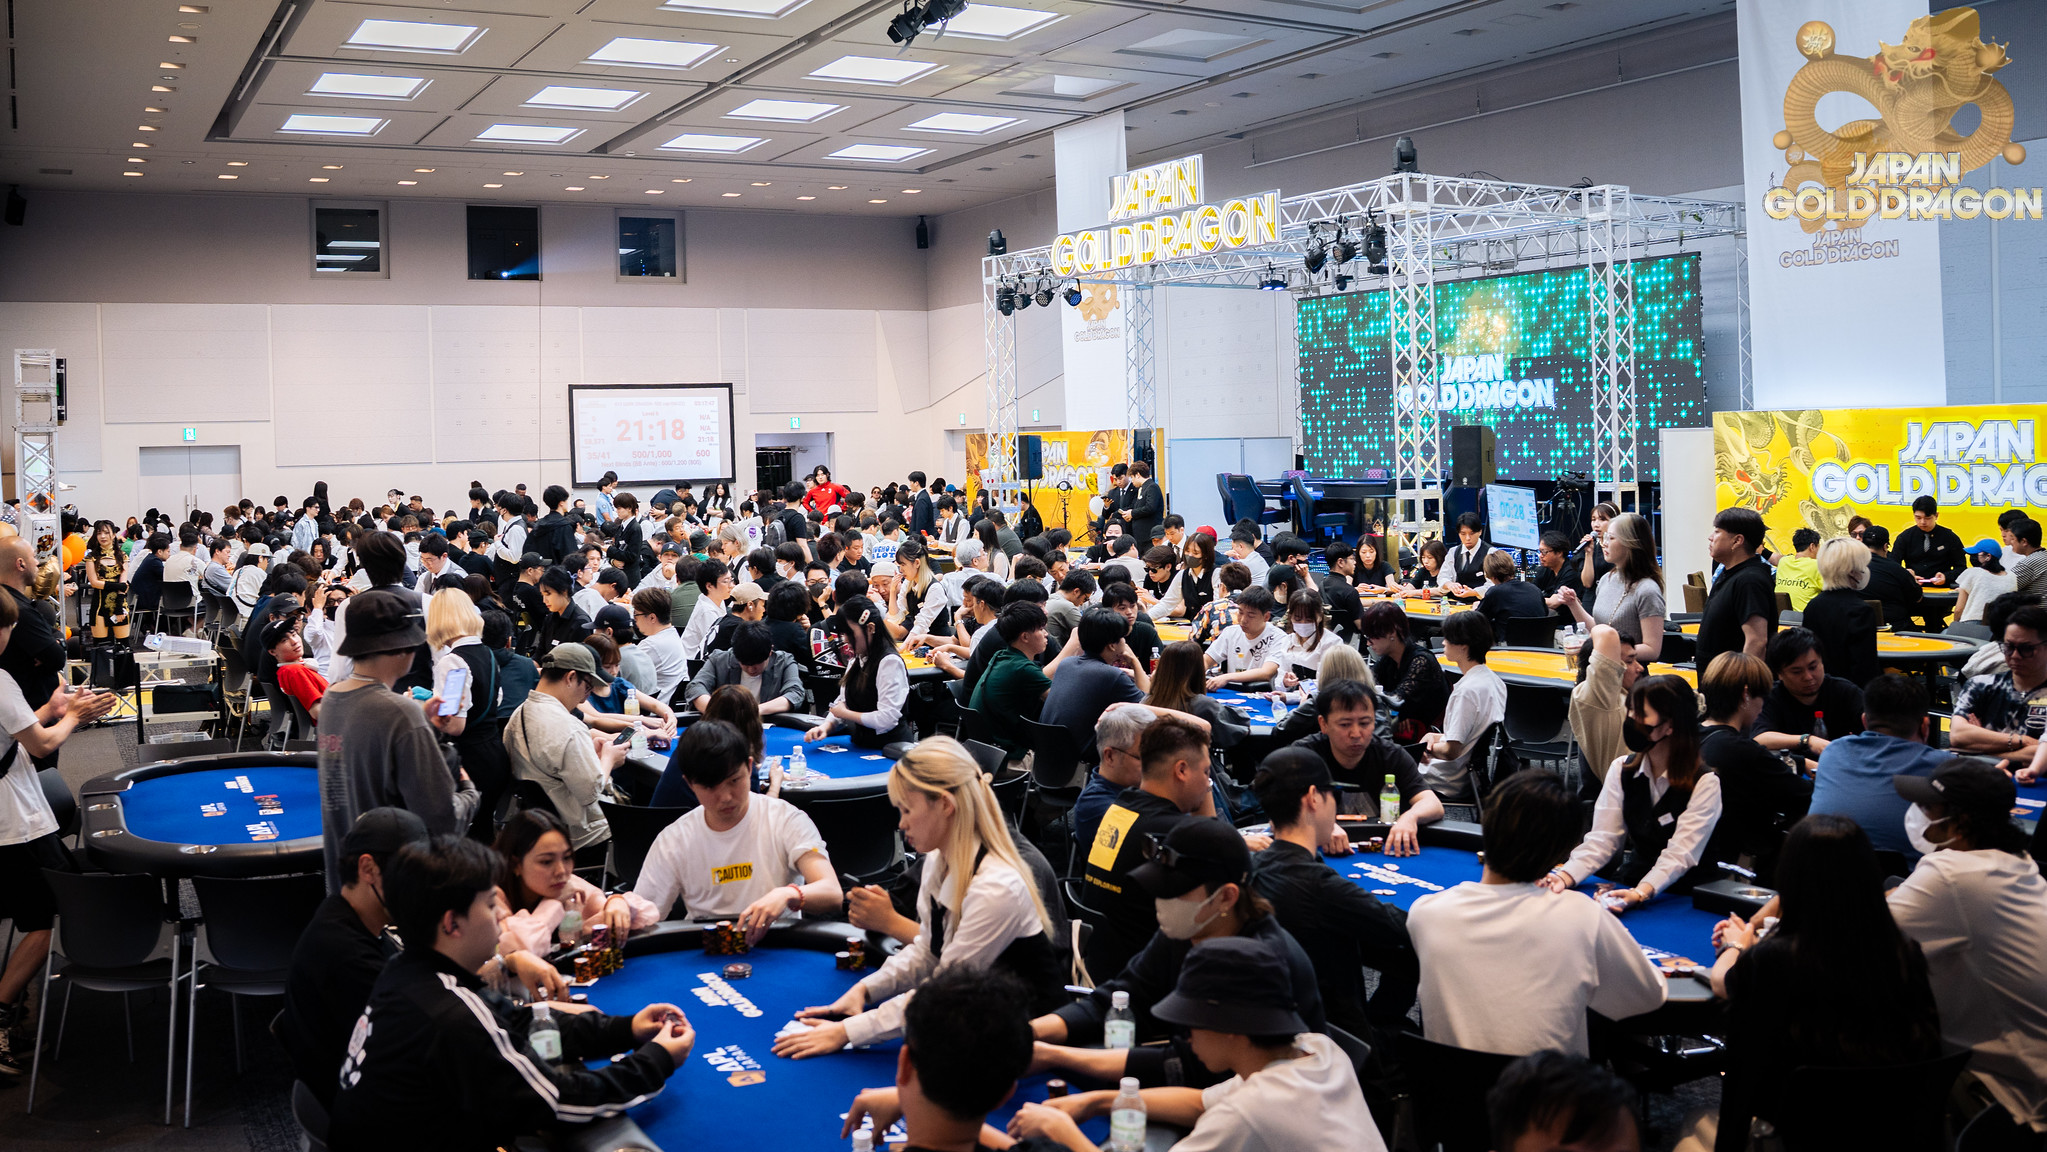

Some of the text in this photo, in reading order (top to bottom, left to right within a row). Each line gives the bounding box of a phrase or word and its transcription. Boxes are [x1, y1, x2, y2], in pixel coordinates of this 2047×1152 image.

[1108, 155, 1200, 221] JAPAN
[1813, 228, 1862, 248] JAPAN
[1439, 353, 1505, 383] JAPAN
[616, 419, 685, 441] 21:18
[1899, 419, 2035, 464] JAPAN
[632, 450, 672, 459] 500/1,000
[696, 449, 711, 457] 600
[1500, 501, 1525, 520] 00:28
[716, 865, 753, 882] CAUTION
